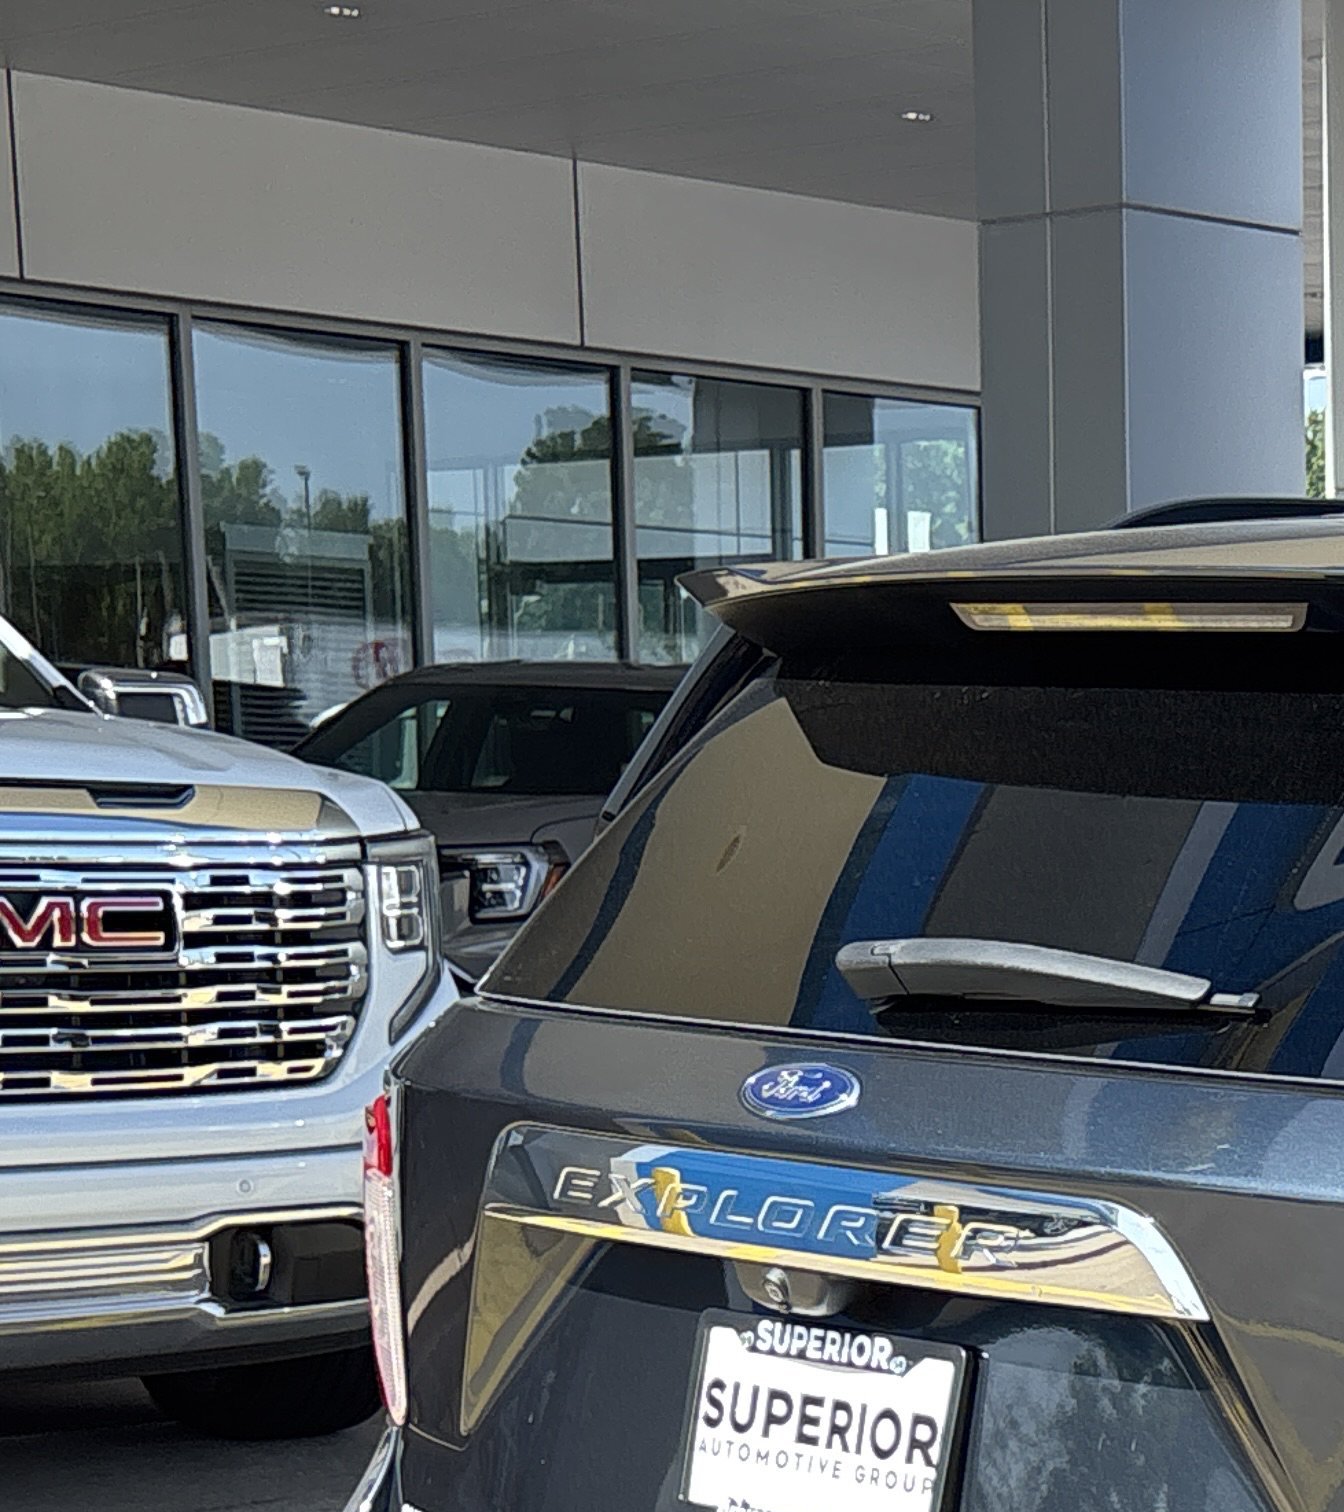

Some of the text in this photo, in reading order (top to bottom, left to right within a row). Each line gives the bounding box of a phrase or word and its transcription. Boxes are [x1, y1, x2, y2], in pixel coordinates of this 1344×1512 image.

[0, 897, 165, 949] MC
[761, 1070, 832, 1103] Ford
[553, 1166, 1020, 1268] EXPLORER
[756, 1319, 894, 1370] SUPERIOR
[703, 1378, 938, 1468] SUPERIOR
[698, 1438, 934, 1495] AUTOMOTIVE GROUP
